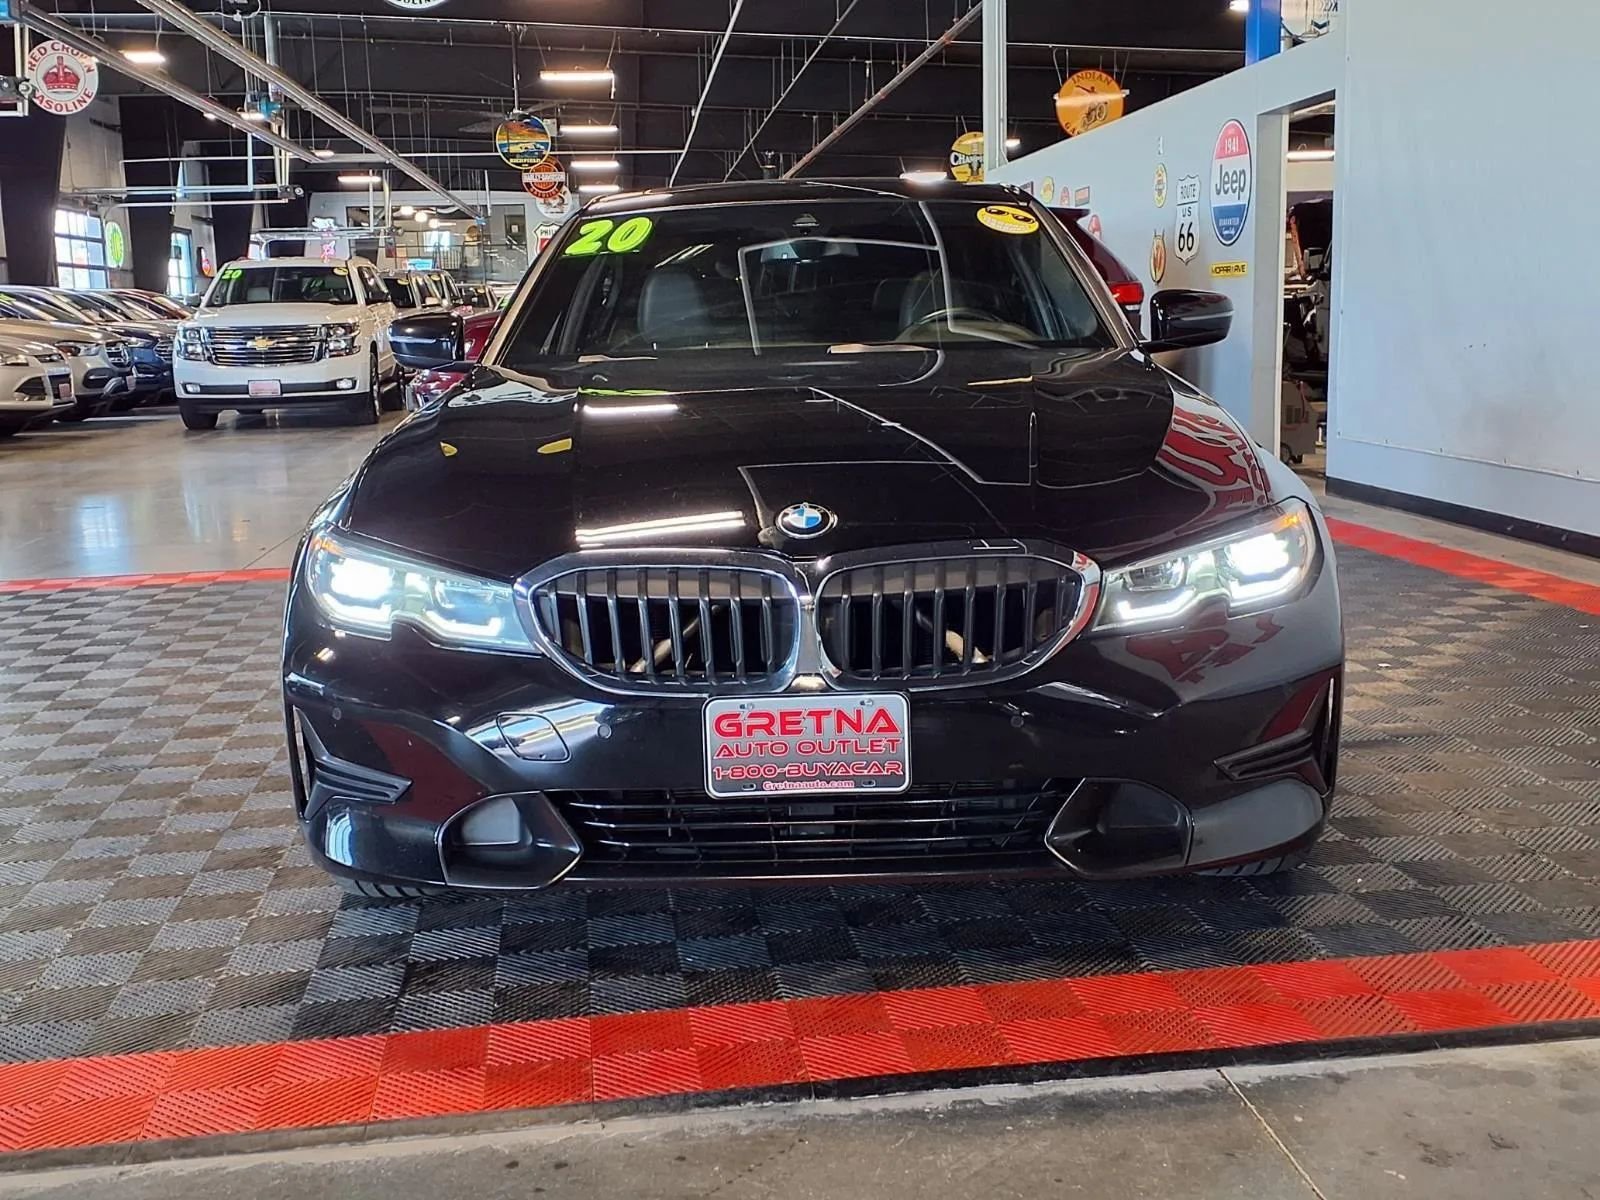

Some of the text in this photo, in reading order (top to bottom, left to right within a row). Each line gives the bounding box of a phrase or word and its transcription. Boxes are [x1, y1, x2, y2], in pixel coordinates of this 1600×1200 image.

[28, 41, 95, 74] RED CRON
[1072, 71, 1112, 87] INDIAN
[33, 88, 94, 113] ASOLINE
[1224, 136, 1239, 155] 1941
[1180, 183, 1197, 199] ROUTE
[1215, 164, 1247, 200] Jeep
[1182, 206, 1192, 217] US
[564, 216, 653, 255] 20
[1178, 222, 1194, 252] 66
[222, 268, 243, 280] 20
[713, 708, 901, 738] GRETNA
[714, 738, 902, 759] AUTO OUTLET
[713, 761, 903, 780] 1-800-BUYACAR
[762, 779, 854, 790] Gretnaauto.com
